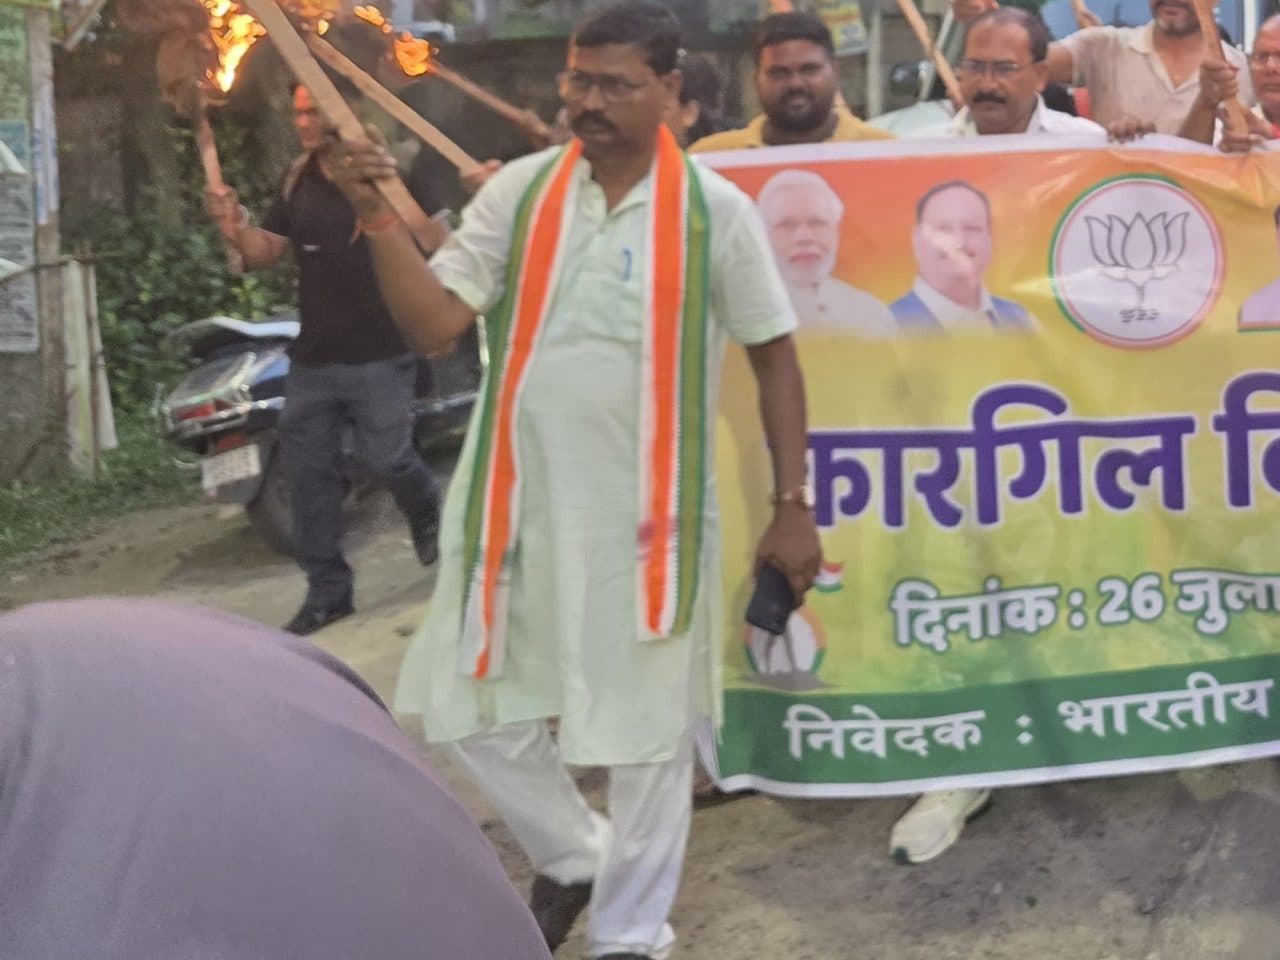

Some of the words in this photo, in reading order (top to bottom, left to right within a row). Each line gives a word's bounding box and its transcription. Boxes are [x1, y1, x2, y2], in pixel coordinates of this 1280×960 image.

[806, 384, 1196, 528] कारगिल
[891, 575, 1060, 652] दिनांक
[1098, 573, 1165, 624] 26
[784, 704, 986, 759] निवेदक
[1057, 672, 1274, 738] भारतीय
